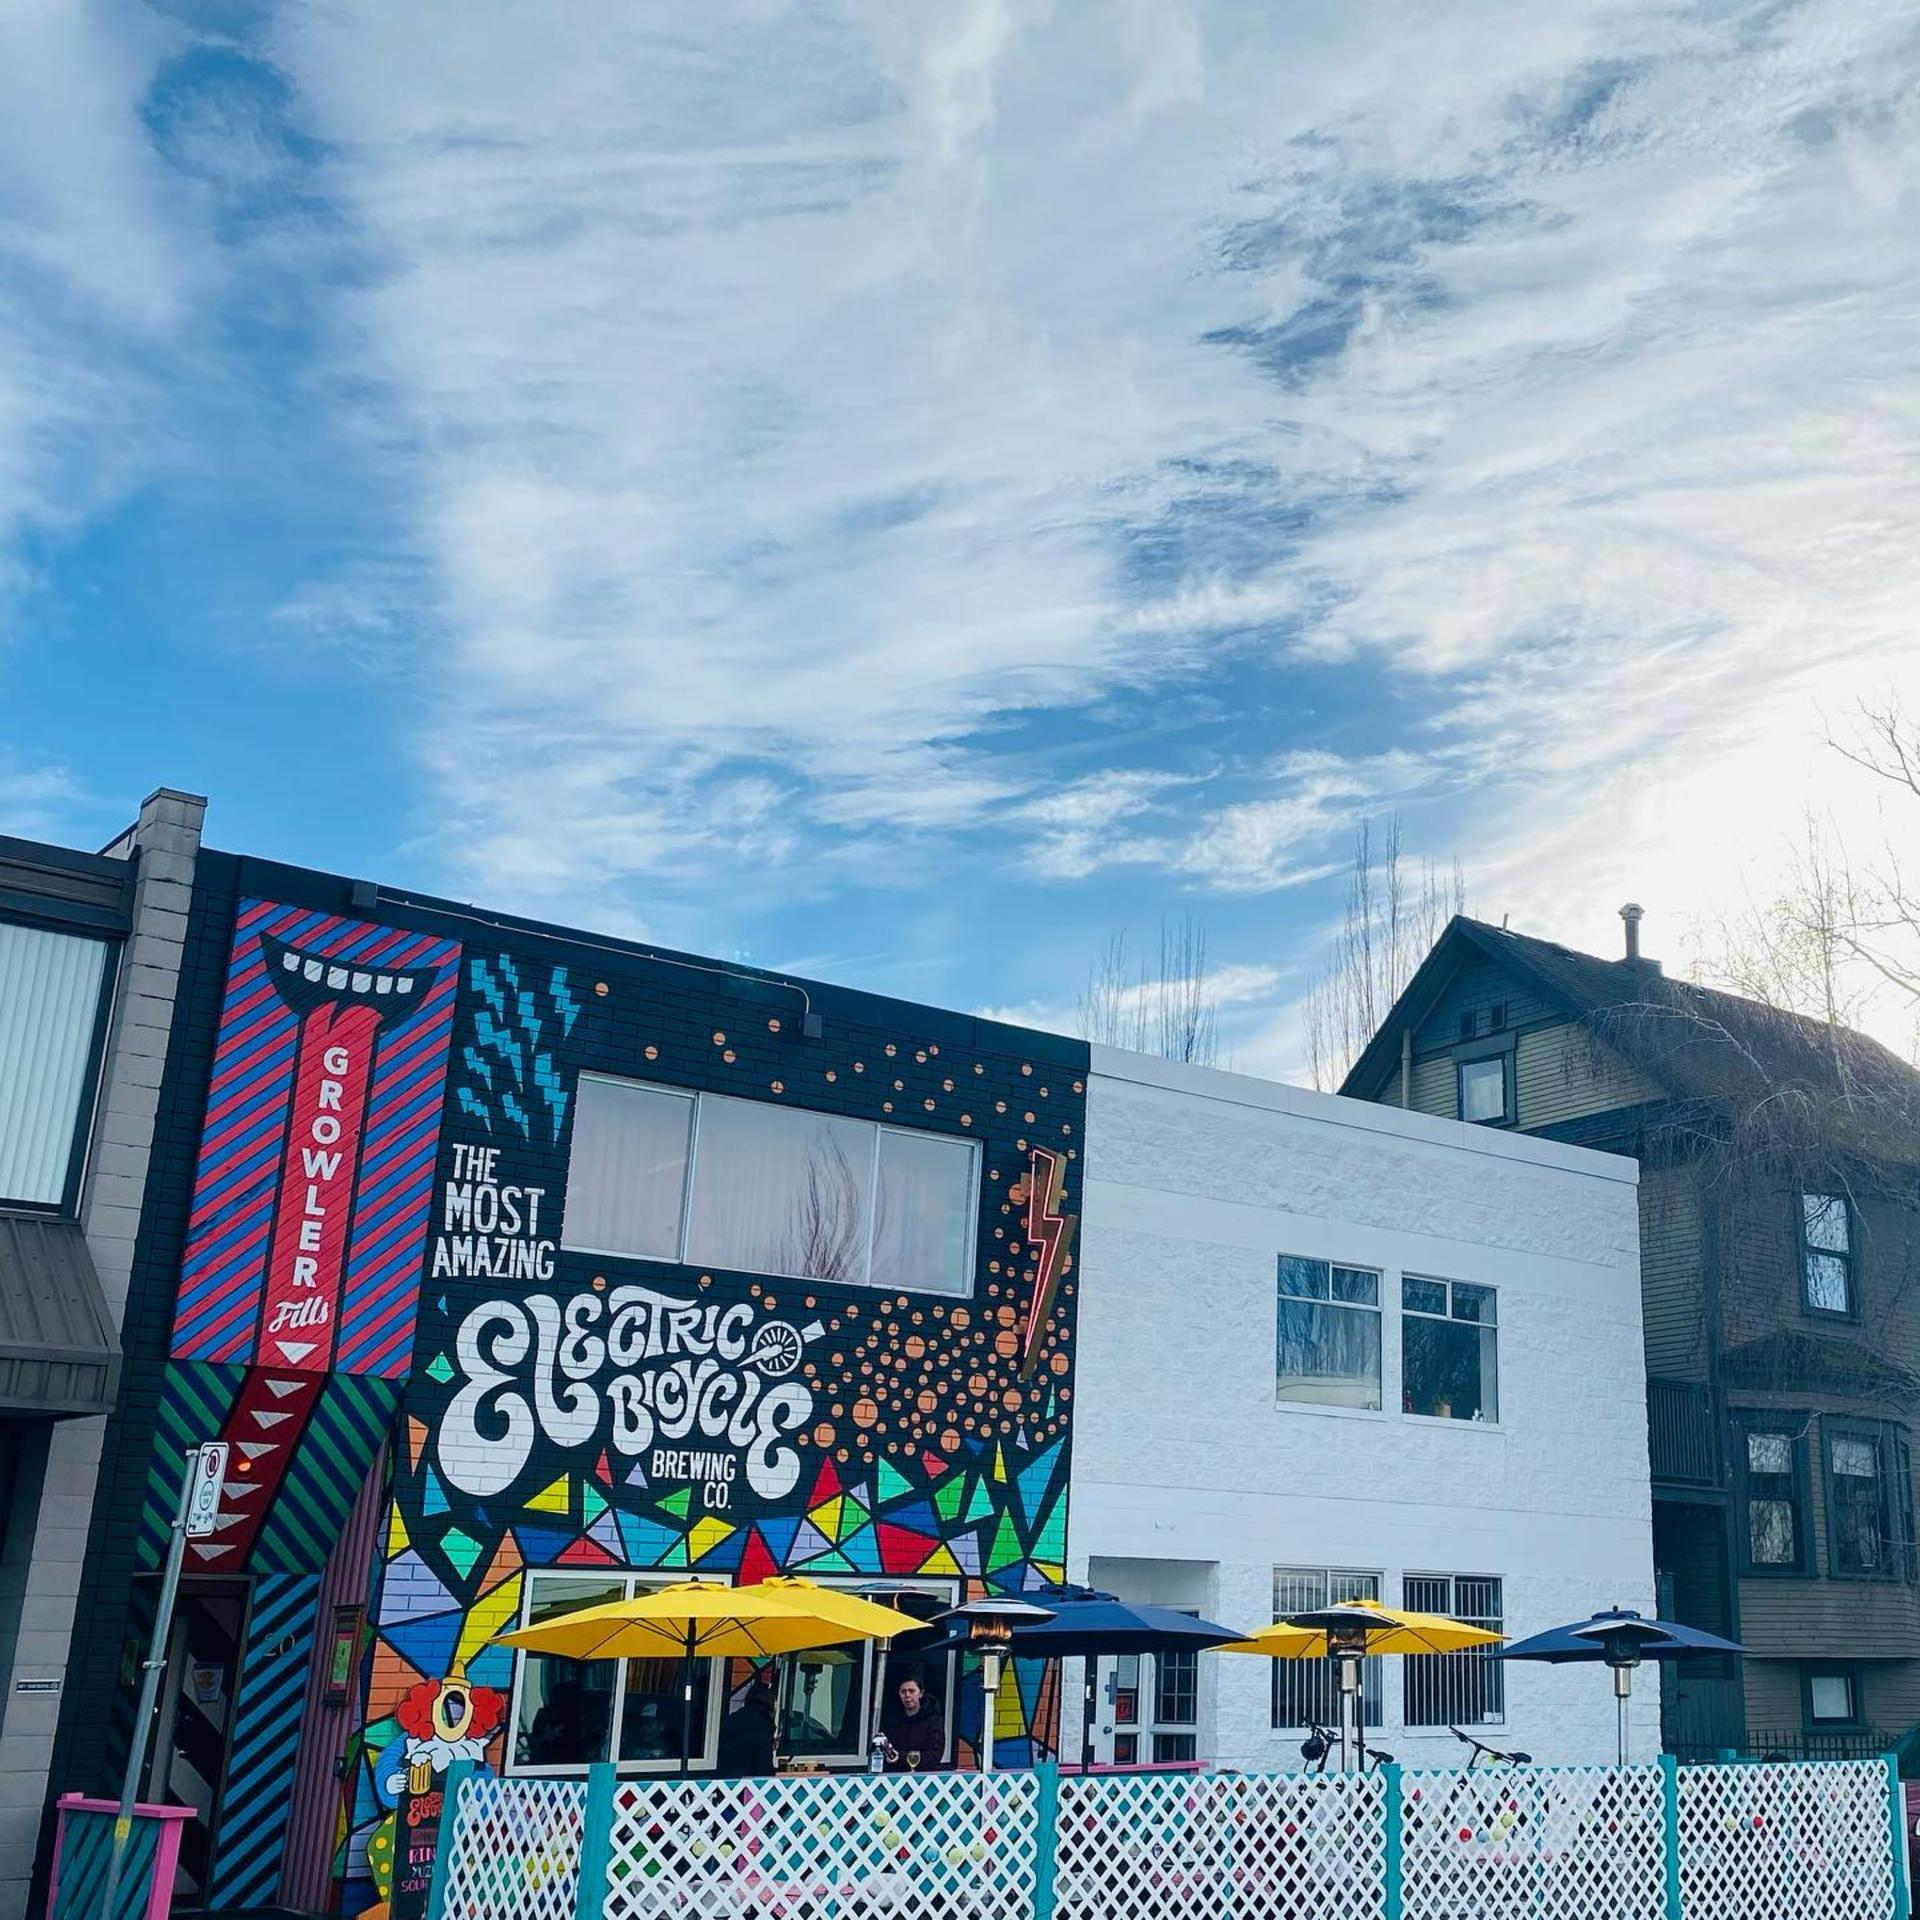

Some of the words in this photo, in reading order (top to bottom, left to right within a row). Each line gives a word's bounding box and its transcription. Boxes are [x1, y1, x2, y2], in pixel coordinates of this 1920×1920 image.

[292, 1047, 349, 1288] GROWLER
[452, 1143, 501, 1184] THE
[445, 1181, 545, 1236] MOST
[431, 1235, 555, 1281] AMAZING
[268, 1295, 329, 1333] Fills
[651, 1448, 736, 1482] BREWING
[702, 1481, 733, 1510] CO.
